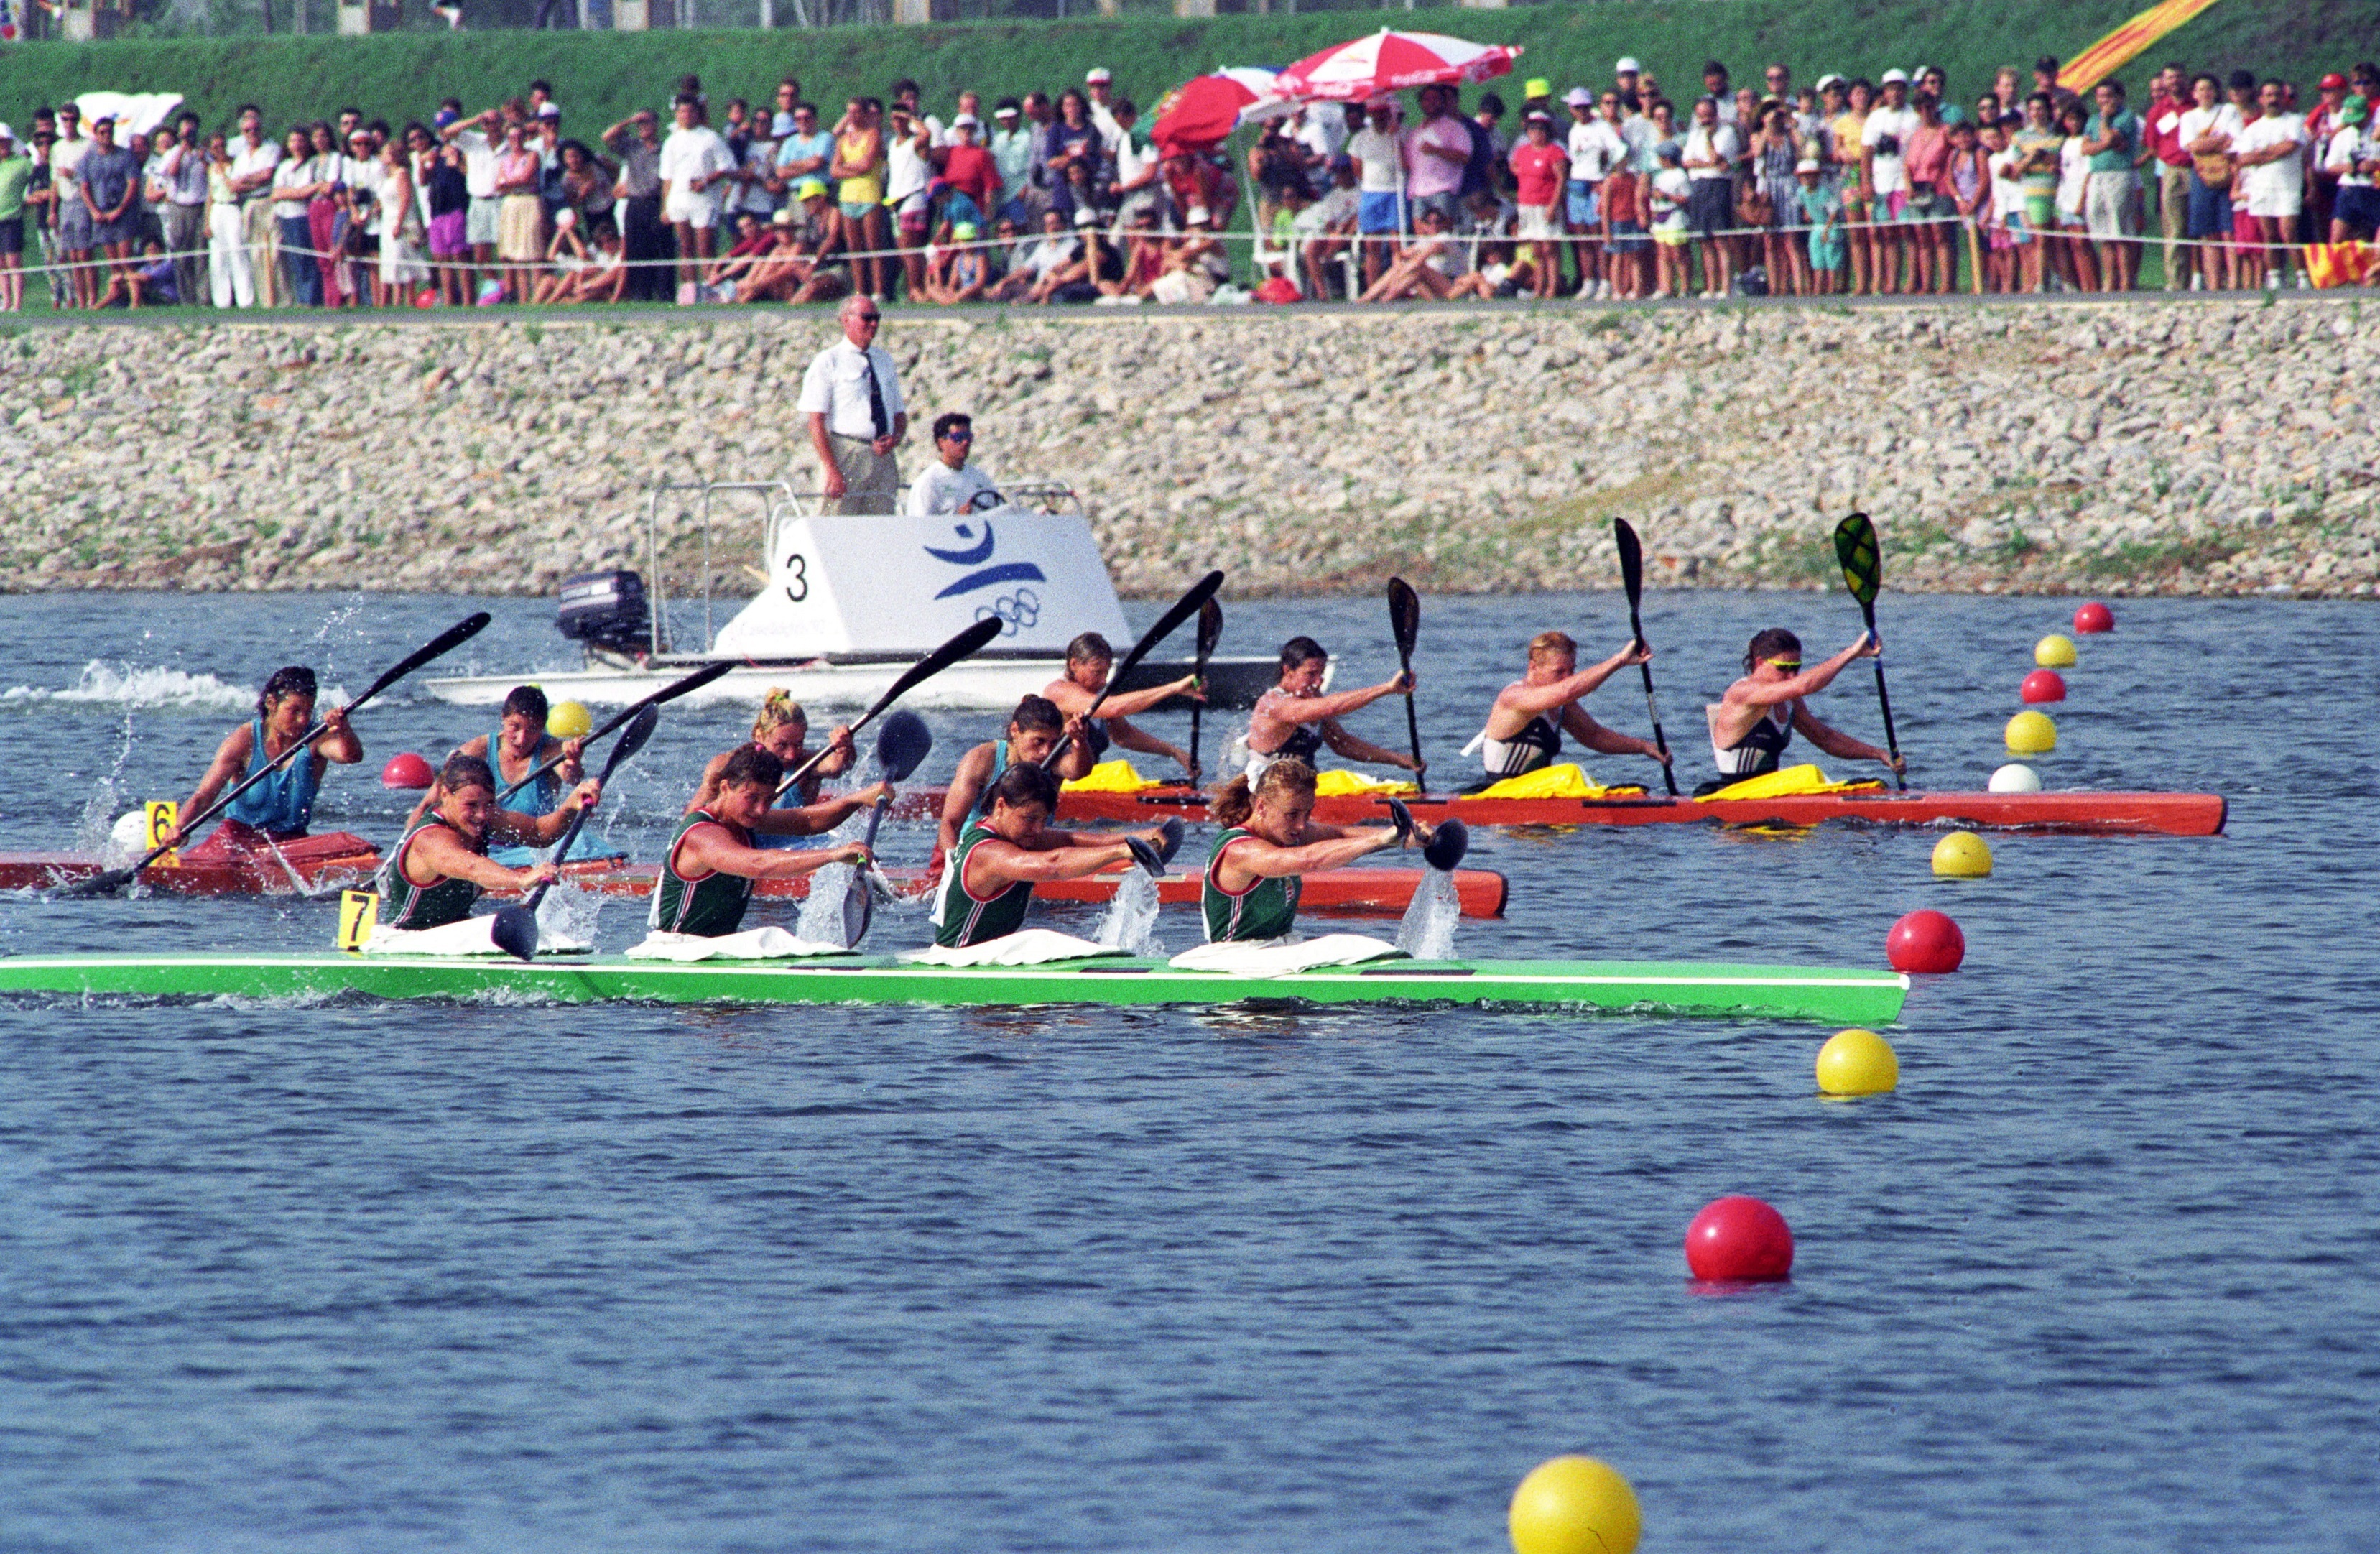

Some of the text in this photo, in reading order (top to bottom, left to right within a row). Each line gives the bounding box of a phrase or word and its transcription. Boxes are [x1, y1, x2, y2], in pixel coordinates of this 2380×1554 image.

[787, 553, 807, 602] 3
[153, 803, 170, 846] 6
[351, 894, 370, 942] 7
